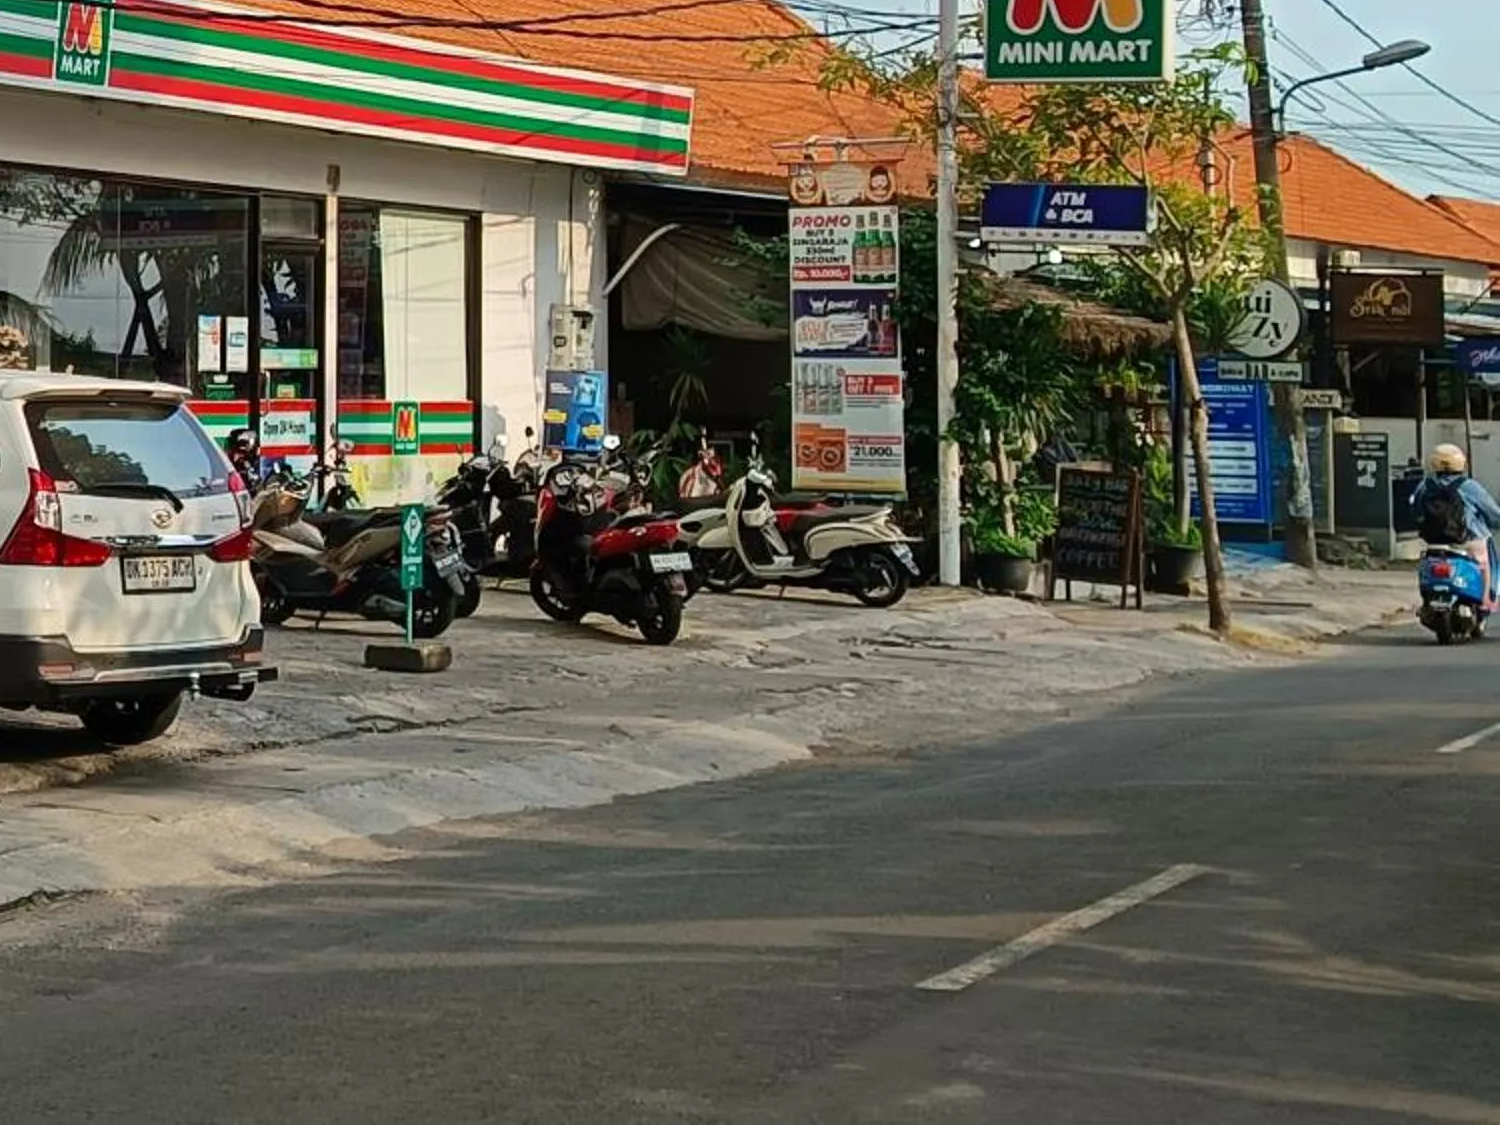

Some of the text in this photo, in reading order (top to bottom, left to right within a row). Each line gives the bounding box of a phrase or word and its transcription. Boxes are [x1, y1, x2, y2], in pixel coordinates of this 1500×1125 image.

[998, 39, 1152, 64] MINI MART
[60, 55, 100, 78] MART
[1050, 191, 1086, 207] ATM
[792, 215, 851, 228] PROMO
[1060, 208, 1094, 224] BCA
[794, 255, 847, 265] DISCOUNT
